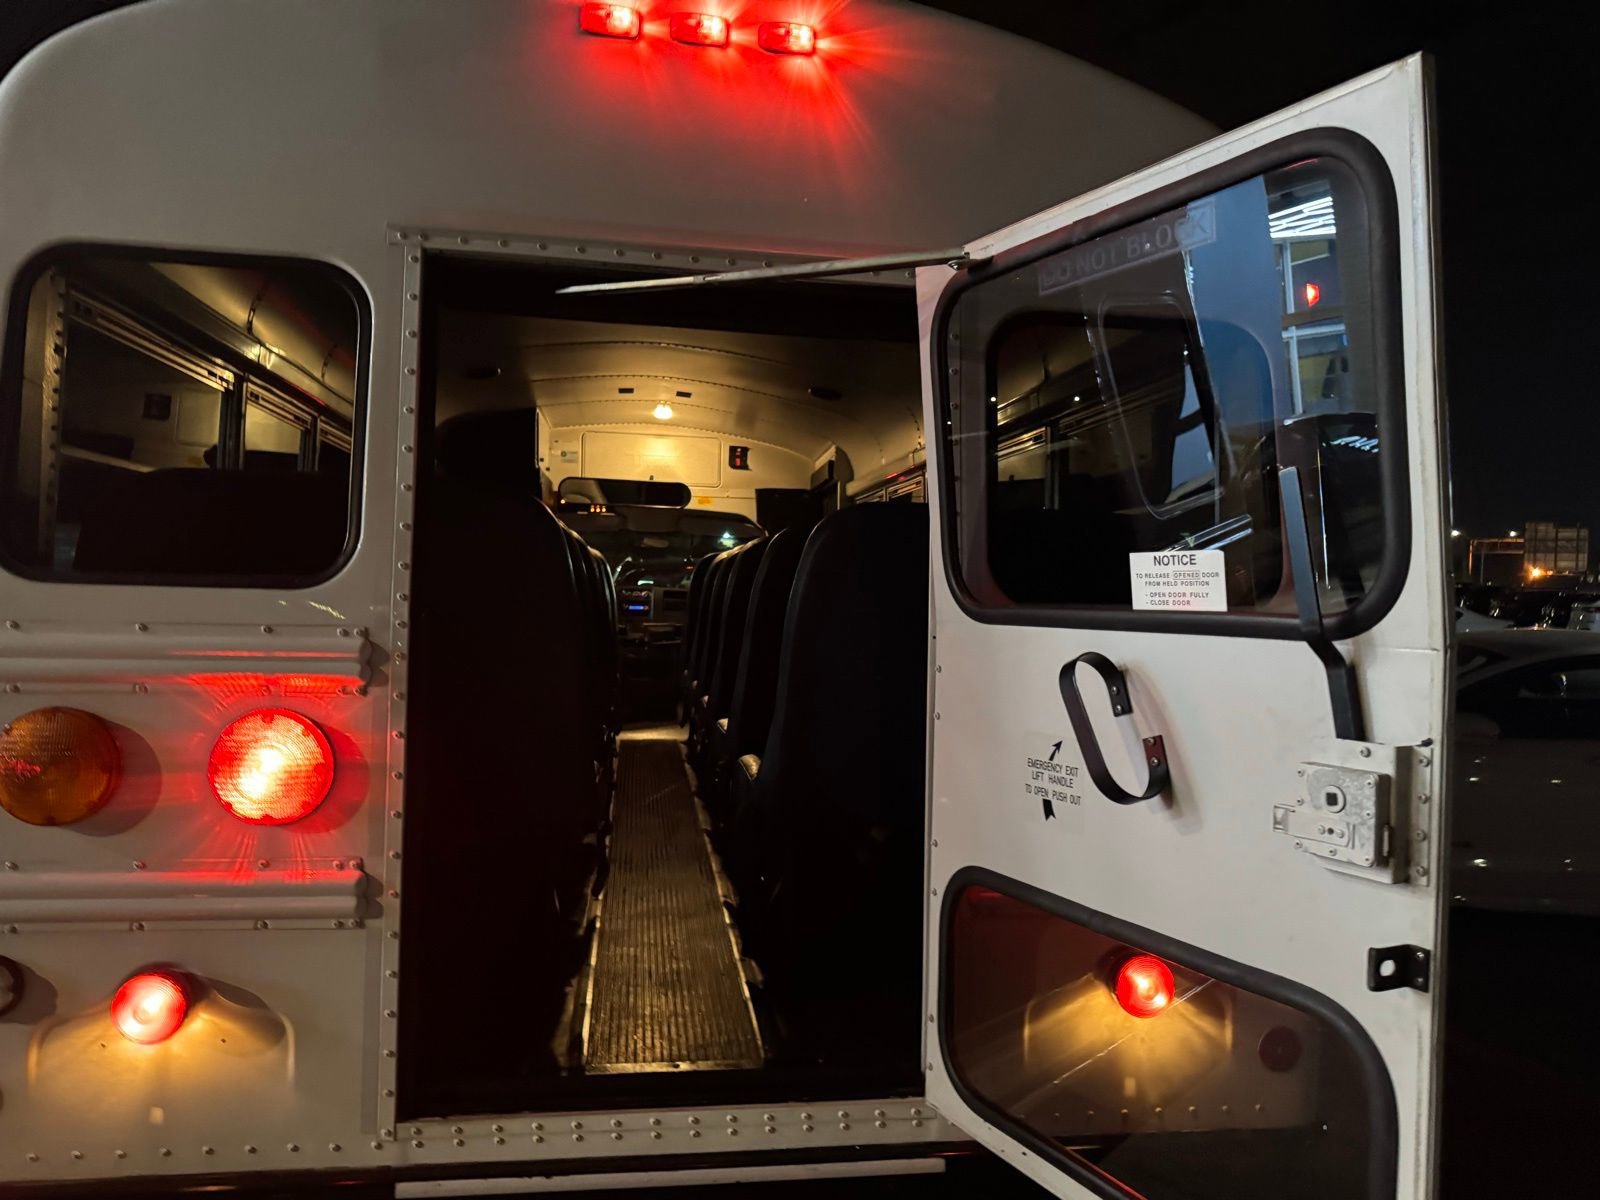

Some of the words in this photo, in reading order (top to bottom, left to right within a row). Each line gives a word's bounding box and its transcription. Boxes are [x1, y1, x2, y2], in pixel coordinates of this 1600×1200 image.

[1042, 261, 1072, 287] DO
[1076, 241, 1120, 277] NOT
[1127, 210, 1210, 259] BLOCK
[1153, 554, 1197, 566] NOTICE
[1027, 758, 1062, 774] EMERGENCY
[1065, 766, 1078, 778] EXIT
[1032, 770, 1044, 781] LIFT
[1048, 774, 1074, 788] HANDLE
[1025, 784, 1032, 794] TO
[1034, 786, 1049, 798] OPEN
[1052, 790, 1067, 802] PUSH
[1070, 794, 1081, 806] OUT
